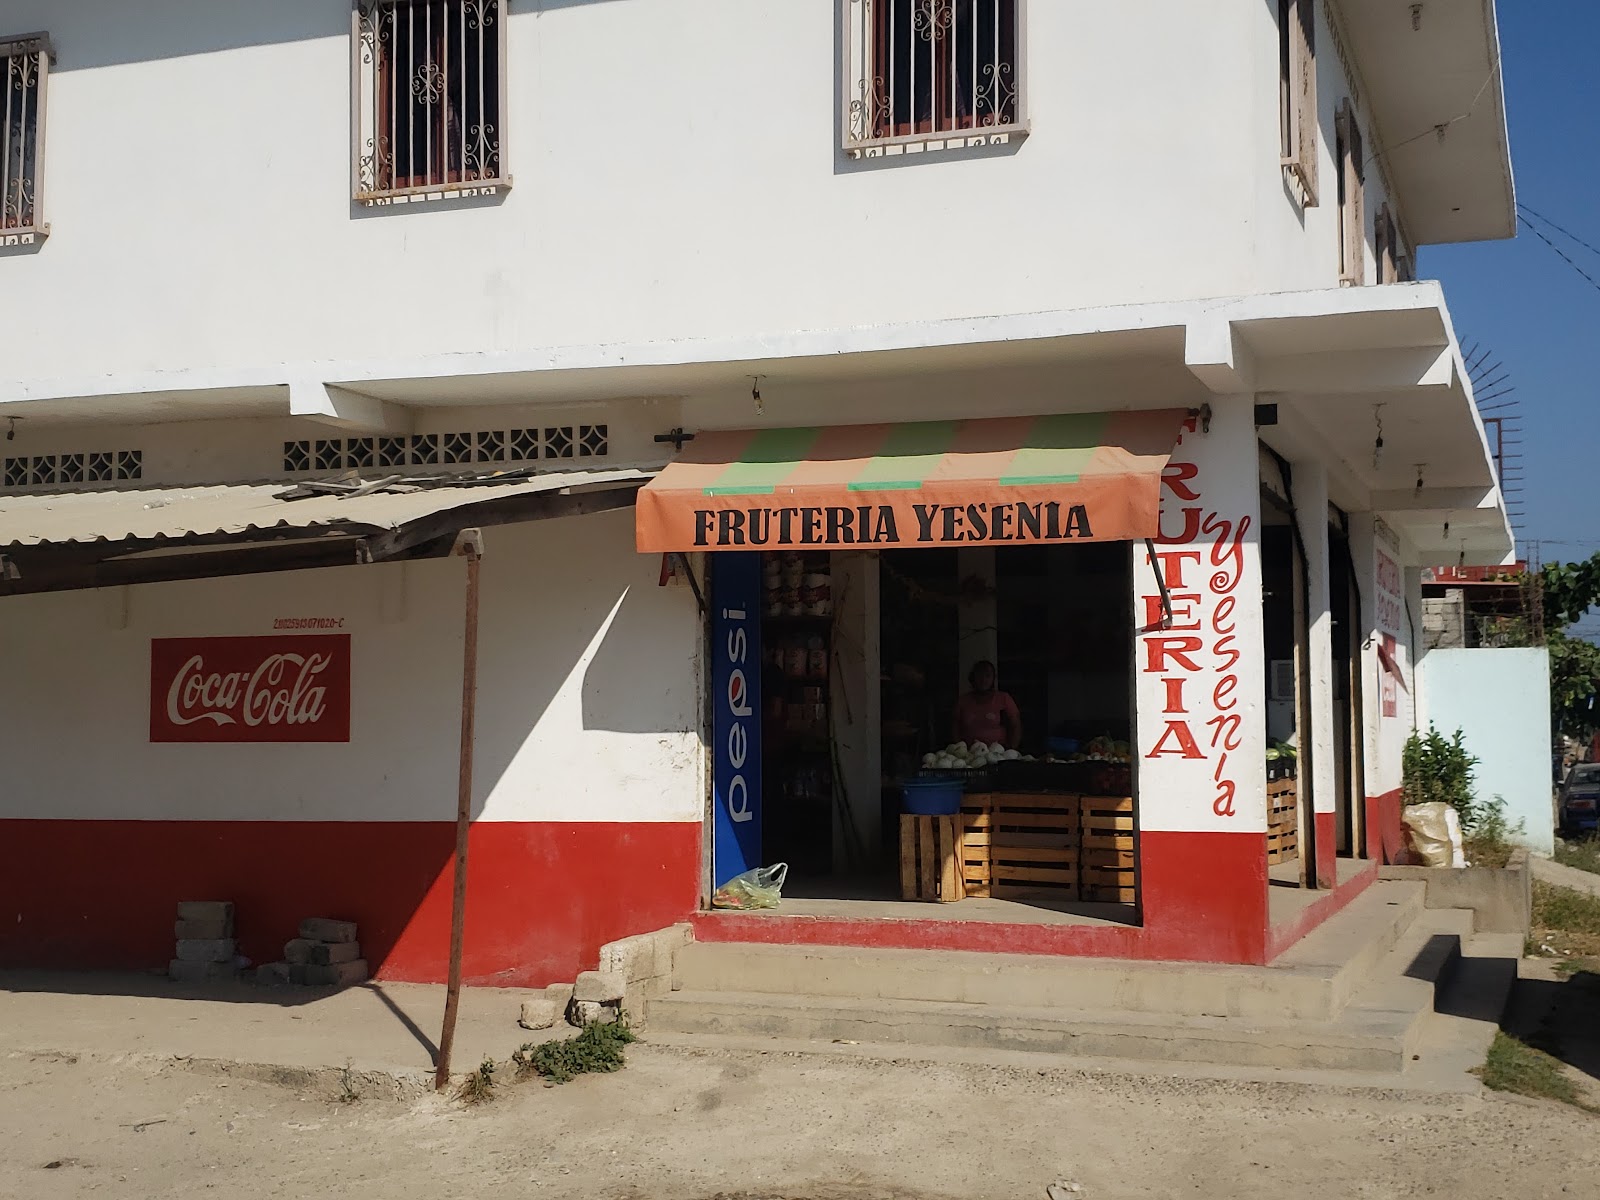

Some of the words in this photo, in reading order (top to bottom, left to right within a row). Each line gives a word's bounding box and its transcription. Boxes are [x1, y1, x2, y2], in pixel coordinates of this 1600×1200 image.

[693, 505, 901, 546] FRUTERIA
[912, 501, 1095, 543] YESENIA
[1142, 417, 1207, 760] RUTERIA
[166, 651, 332, 727] Coca-Cola
[723, 608, 753, 823] pepsi
